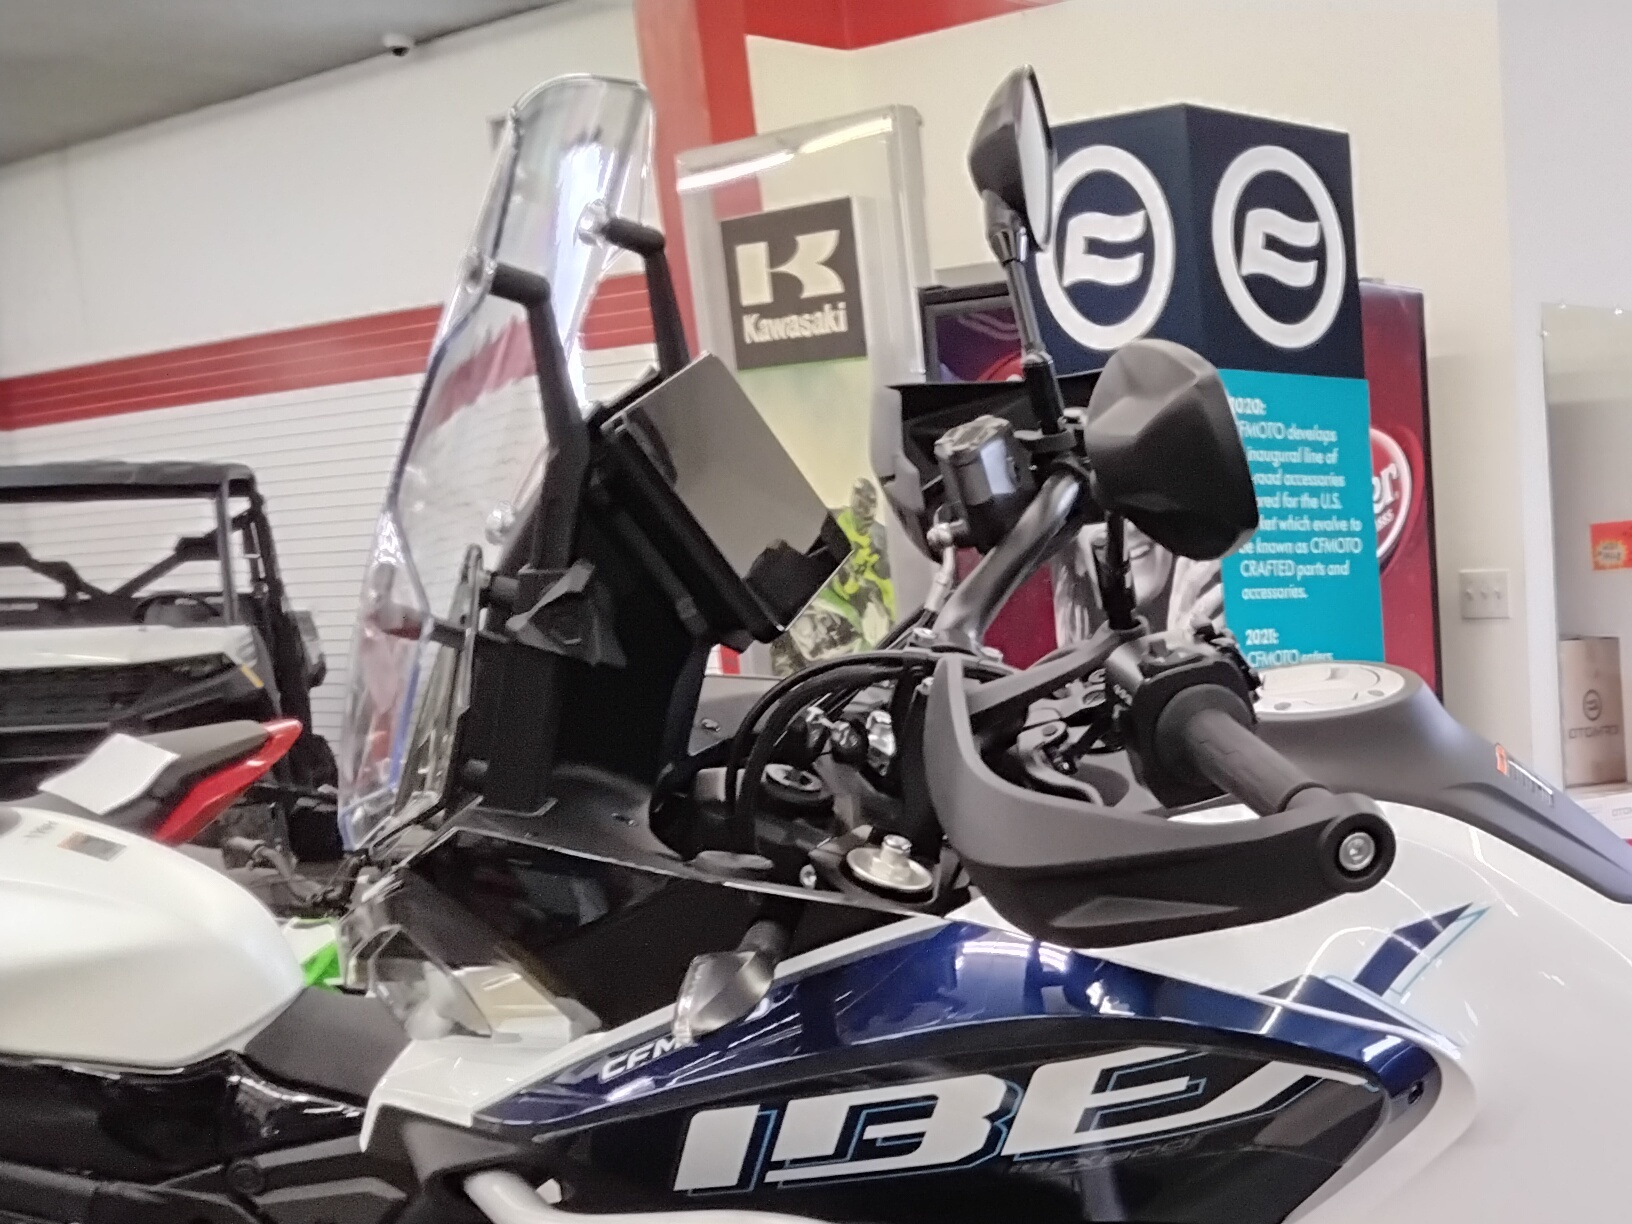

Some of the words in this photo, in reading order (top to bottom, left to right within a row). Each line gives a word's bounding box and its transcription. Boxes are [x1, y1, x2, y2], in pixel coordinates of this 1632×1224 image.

[742, 302, 848, 345] Kawasaki
[1239, 421, 1286, 439] FMOTO
[1287, 423, 1338, 446] develops
[1303, 447, 1325, 464] line
[1326, 448, 1339, 464] of
[1284, 471, 1346, 487] accessories
[1282, 492, 1300, 508] for
[1300, 493, 1319, 509] the
[1279, 515, 1311, 531] which
[1313, 516, 1348, 532] evolve
[1349, 518, 1363, 532] to
[1256, 538, 1294, 554] known
[1295, 542, 1309, 554] as
[1310, 537, 1363, 554] CFMOTO
[1240, 559, 1296, 577] CRAFTED
[1297, 562, 1326, 581] parts
[1327, 559, 1351, 576] and
[1242, 584, 1309, 600] accessories.
[1245, 628, 1279, 646] 2021:
[1247, 649, 1300, 668] CFMOTO
[601, 1036, 681, 1083] CFM
